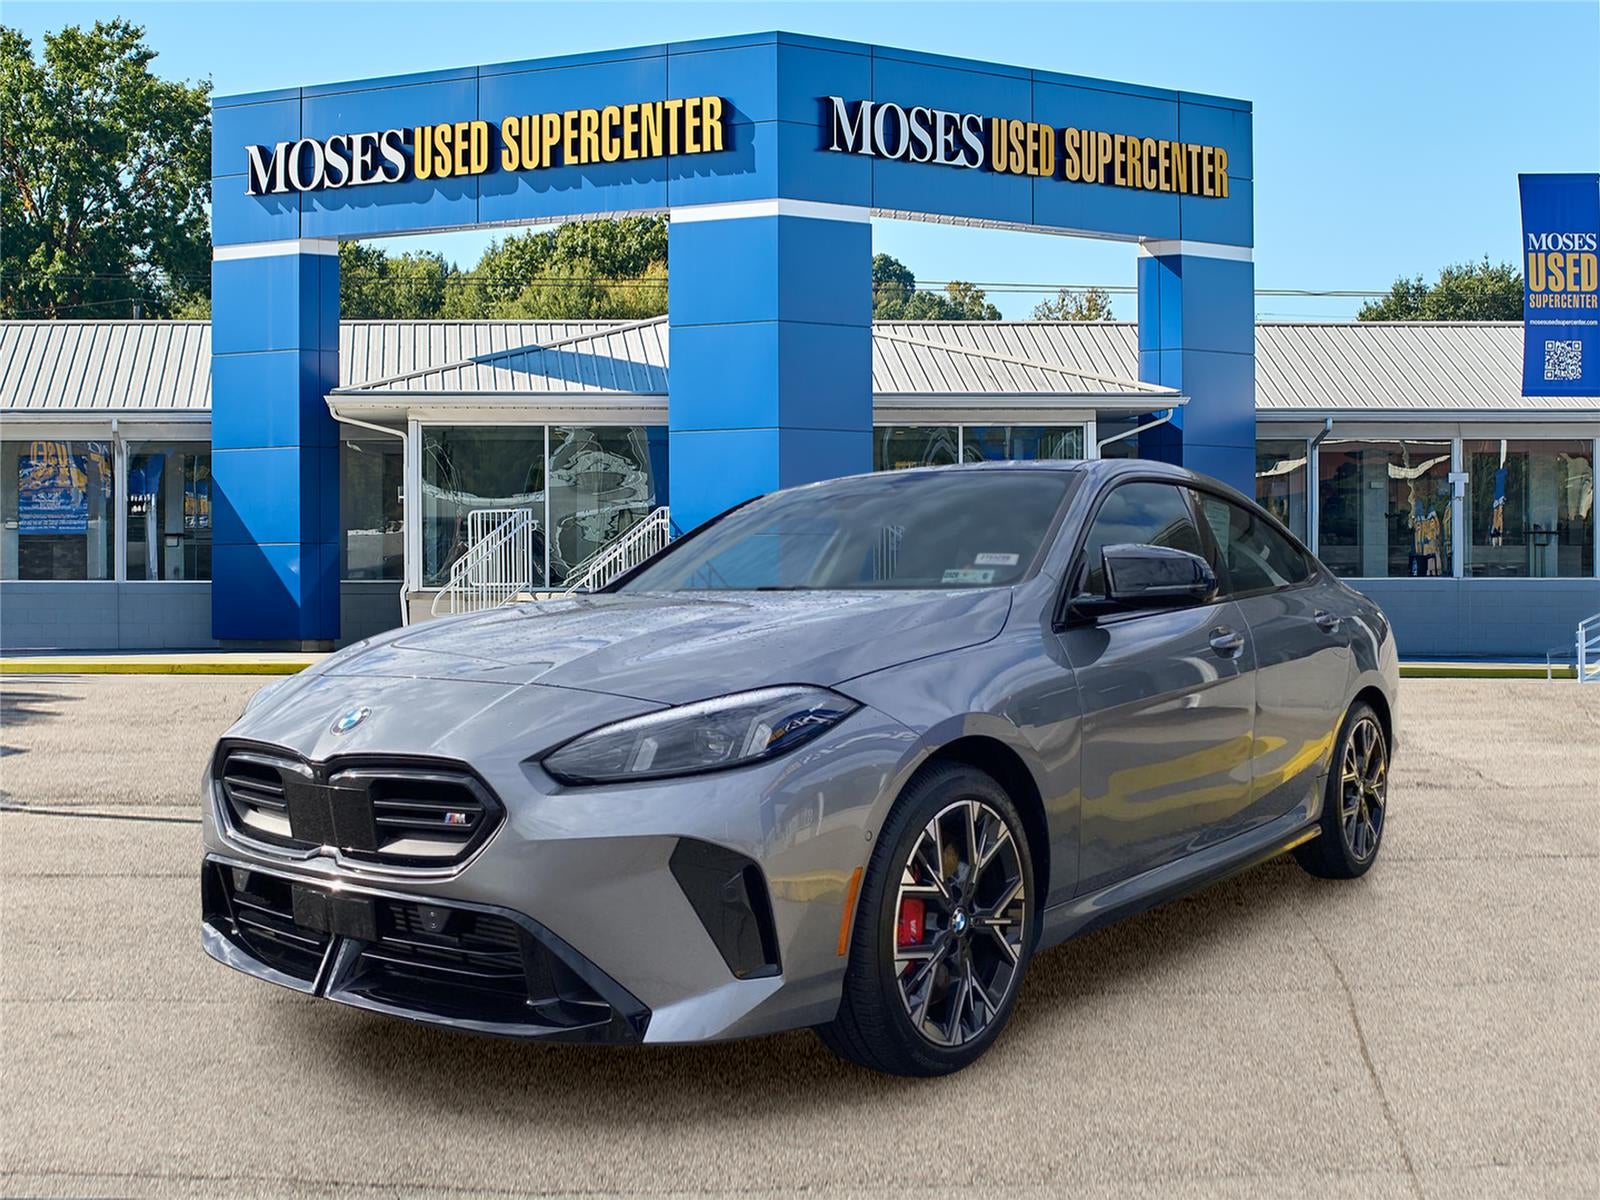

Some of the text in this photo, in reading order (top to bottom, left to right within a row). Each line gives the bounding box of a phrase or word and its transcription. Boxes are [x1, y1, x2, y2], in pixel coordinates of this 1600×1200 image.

[244, 95, 724, 196] MOSES USED SUPERCENTER
[829, 96, 1230, 198] MOSES USED SUPERCENTER
[1528, 233, 1597, 251] MOSES
[1528, 252, 1598, 292] USED
[1529, 294, 1598, 308] SUPERCENTER
